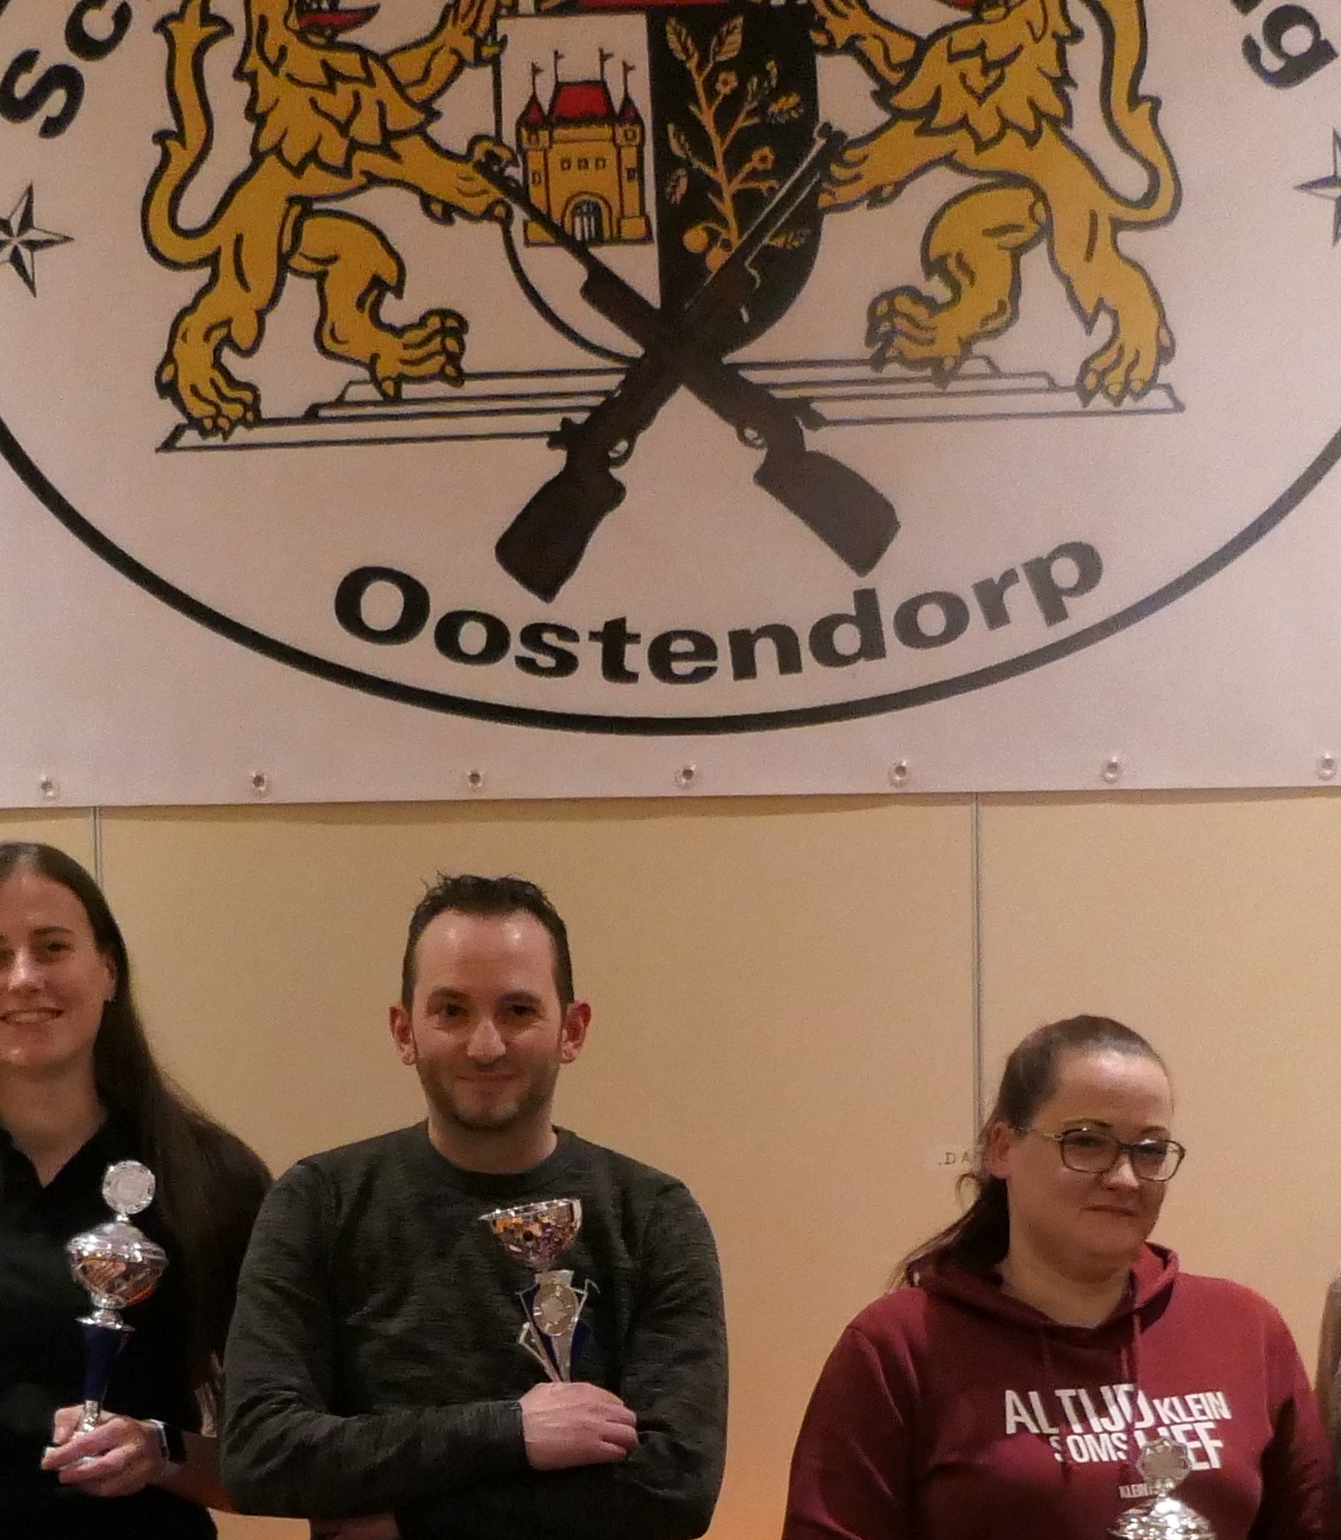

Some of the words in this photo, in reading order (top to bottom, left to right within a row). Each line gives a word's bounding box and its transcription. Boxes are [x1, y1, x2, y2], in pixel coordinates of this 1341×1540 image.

[333, 540, 1105, 685] Oostendorp
[1004, 1383, 1155, 1435] ALTIJD
[1152, 1391, 1233, 1424] KLEIN
[1049, 1431, 1128, 1463] SOMS
